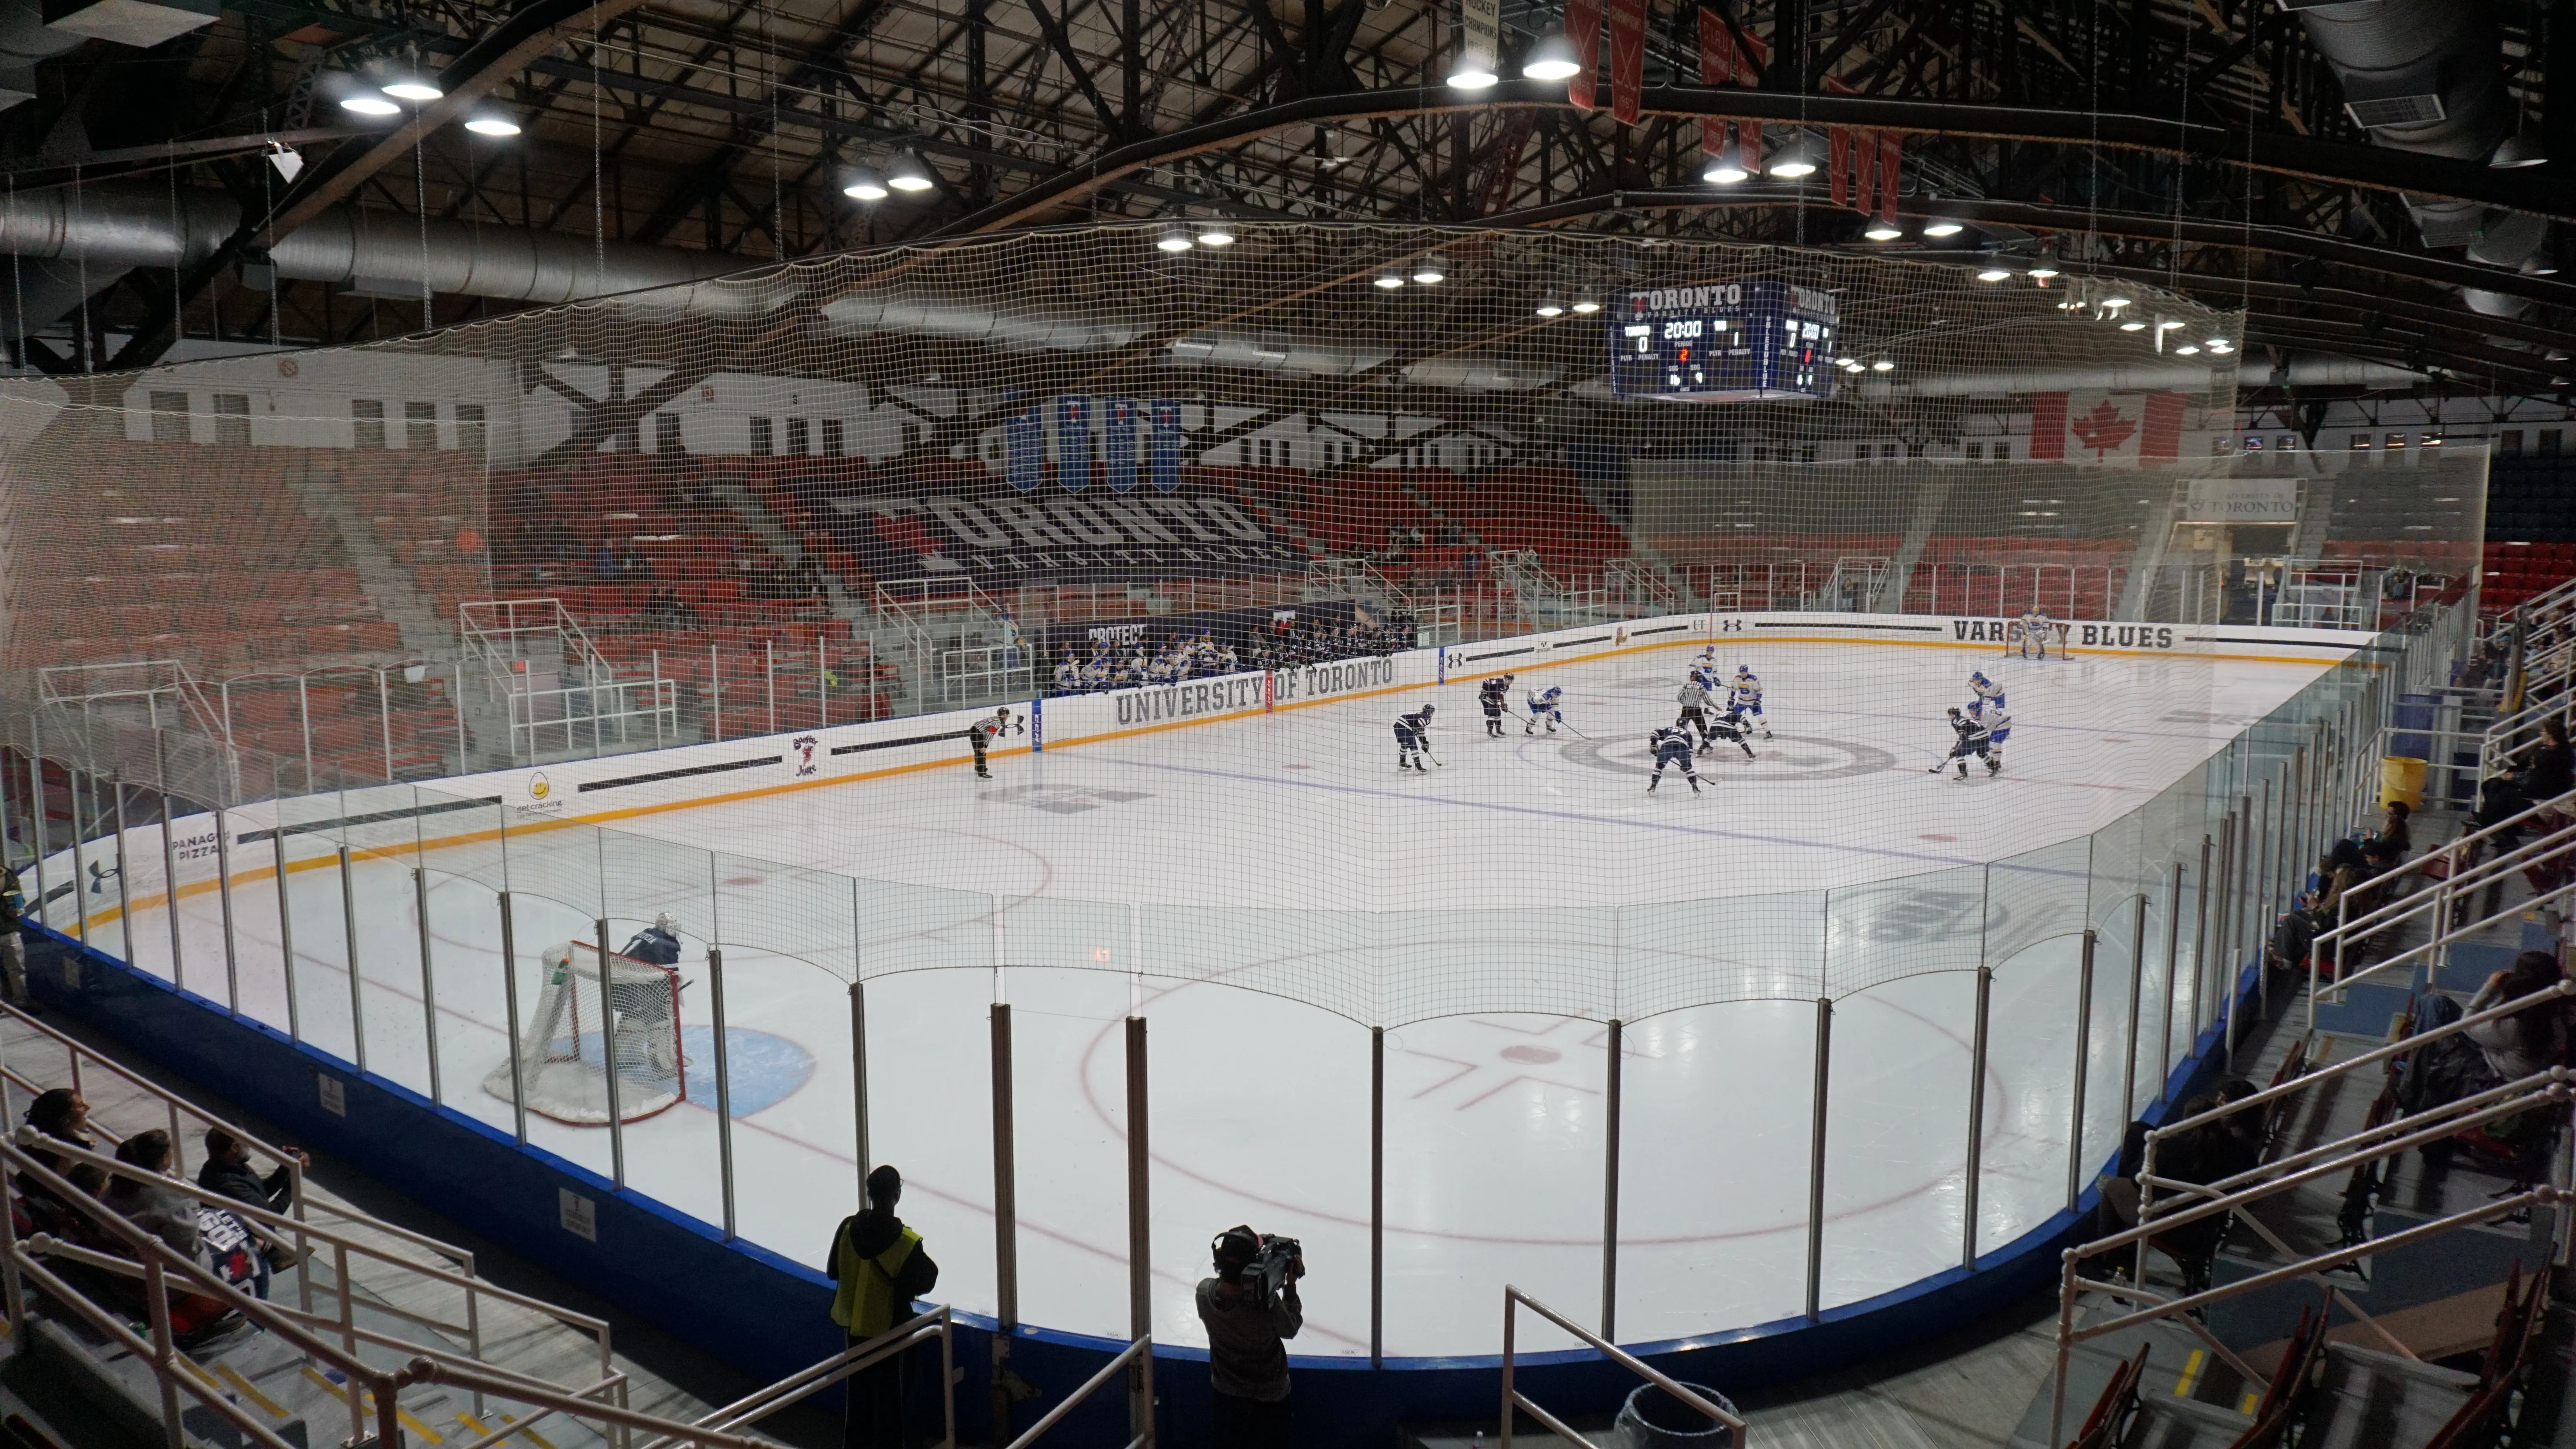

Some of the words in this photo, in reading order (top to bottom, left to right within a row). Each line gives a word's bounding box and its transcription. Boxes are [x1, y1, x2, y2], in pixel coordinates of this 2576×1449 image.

[1464, 15, 1497, 39] CHAMPIONS
[1612, 5, 1641, 32] CHAMPIONS
[1619, 93, 1634, 110] 1967
[1629, 284, 1740, 320] TORONTO
[1791, 286, 1835, 315] TORONTO
[1647, 309, 1696, 318] VARSITY
[1704, 305, 1740, 315] BLUES
[1625, 325, 1650, 336] TORONTO
[1665, 321, 1701, 339] 20:00
[1734, 331, 1739, 346] 1
[1639, 336, 1648, 353] 0
[1680, 348, 1689, 361] 2
[2211, 501, 2293, 513] TORONTO
[826, 497, 1267, 572] TORONTO
[970, 549, 1164, 570] VARSITY
[1179, 544, 1292, 561] BLUES
[1953, 620, 2071, 644] VARSTY
[2082, 624, 2173, 648] BLUES
[1116, 676, 1264, 725] UNIVERSITY
[1274, 671, 1297, 701] OF
[1306, 658, 1393, 696] TORONTO
[516, 804, 529, 813] get
[172, 831, 230, 850] PANAG
[179, 844, 219, 861] PIZZA
